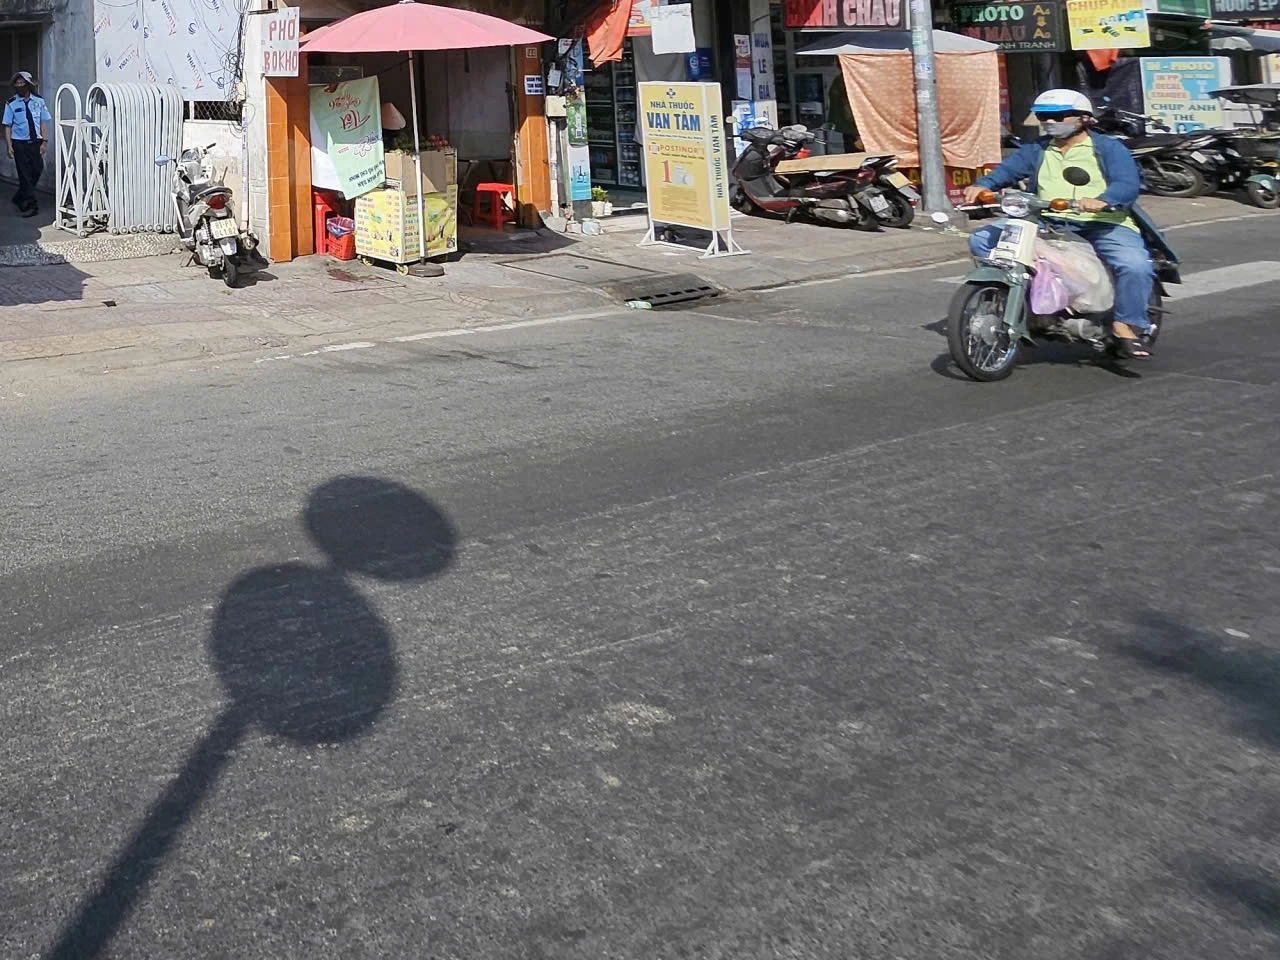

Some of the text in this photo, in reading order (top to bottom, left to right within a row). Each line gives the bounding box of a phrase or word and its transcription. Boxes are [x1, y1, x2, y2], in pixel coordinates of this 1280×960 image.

[960, 5, 1024, 23] PHOTO
[983, 21, 1026, 42] MÀU
[650, 100, 695, 110] NHÀ THUỐC
[646, 111, 701, 132] VẠN TÂM
[713, 157, 722, 182] THUỐC
[715, 184, 724, 198] NHÀ
